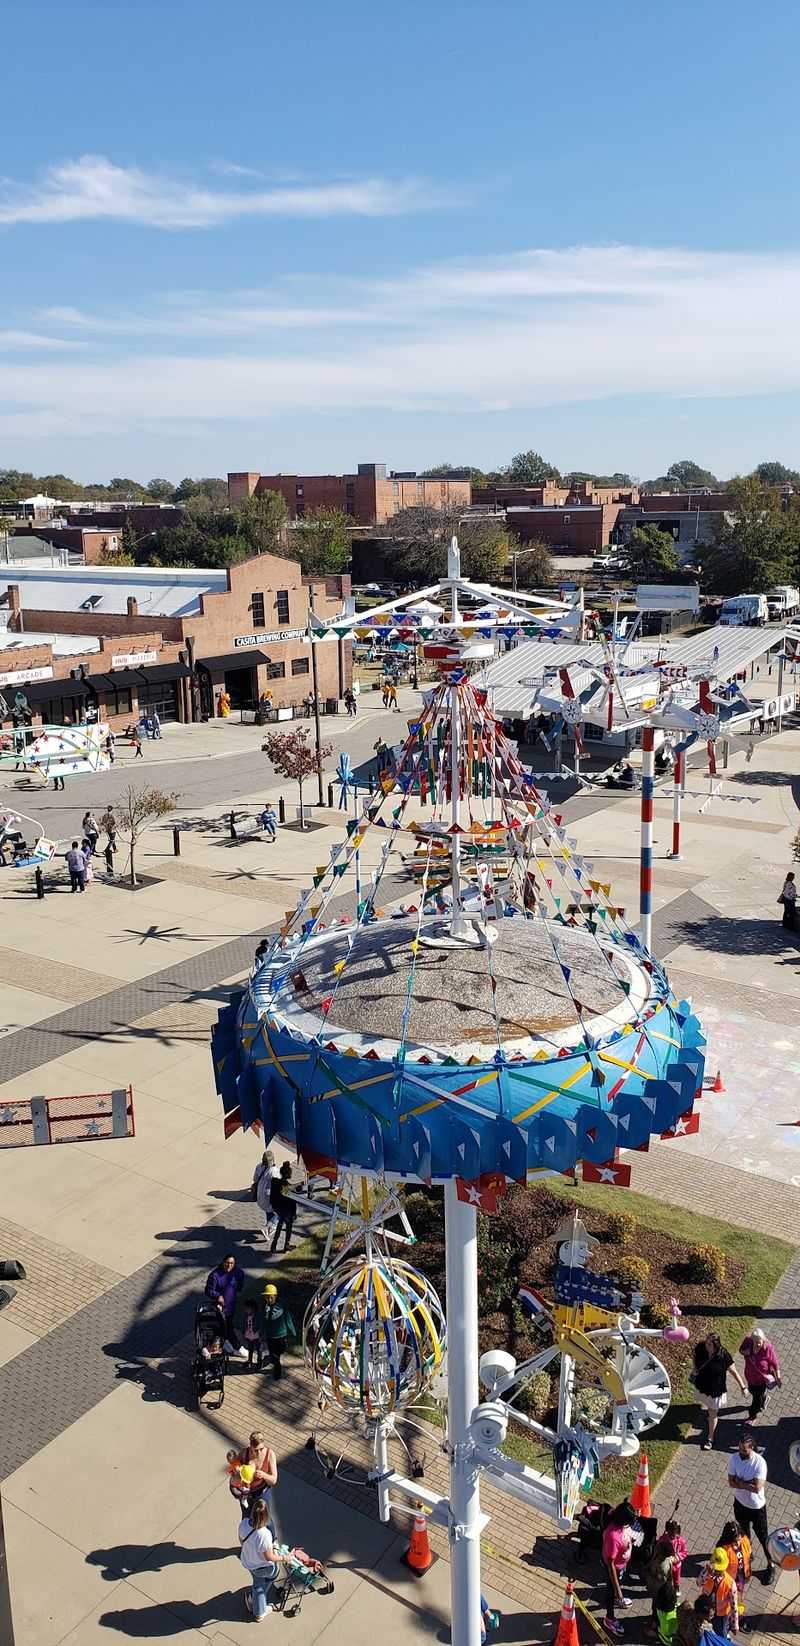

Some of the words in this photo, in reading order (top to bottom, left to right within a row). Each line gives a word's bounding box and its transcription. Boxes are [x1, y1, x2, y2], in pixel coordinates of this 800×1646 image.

[236, 636, 256, 646] CASITA
[256, 633, 281, 643] BREWING
[281, 629, 306, 639] COMPANY
[16, 671, 43, 681] ARCADE
